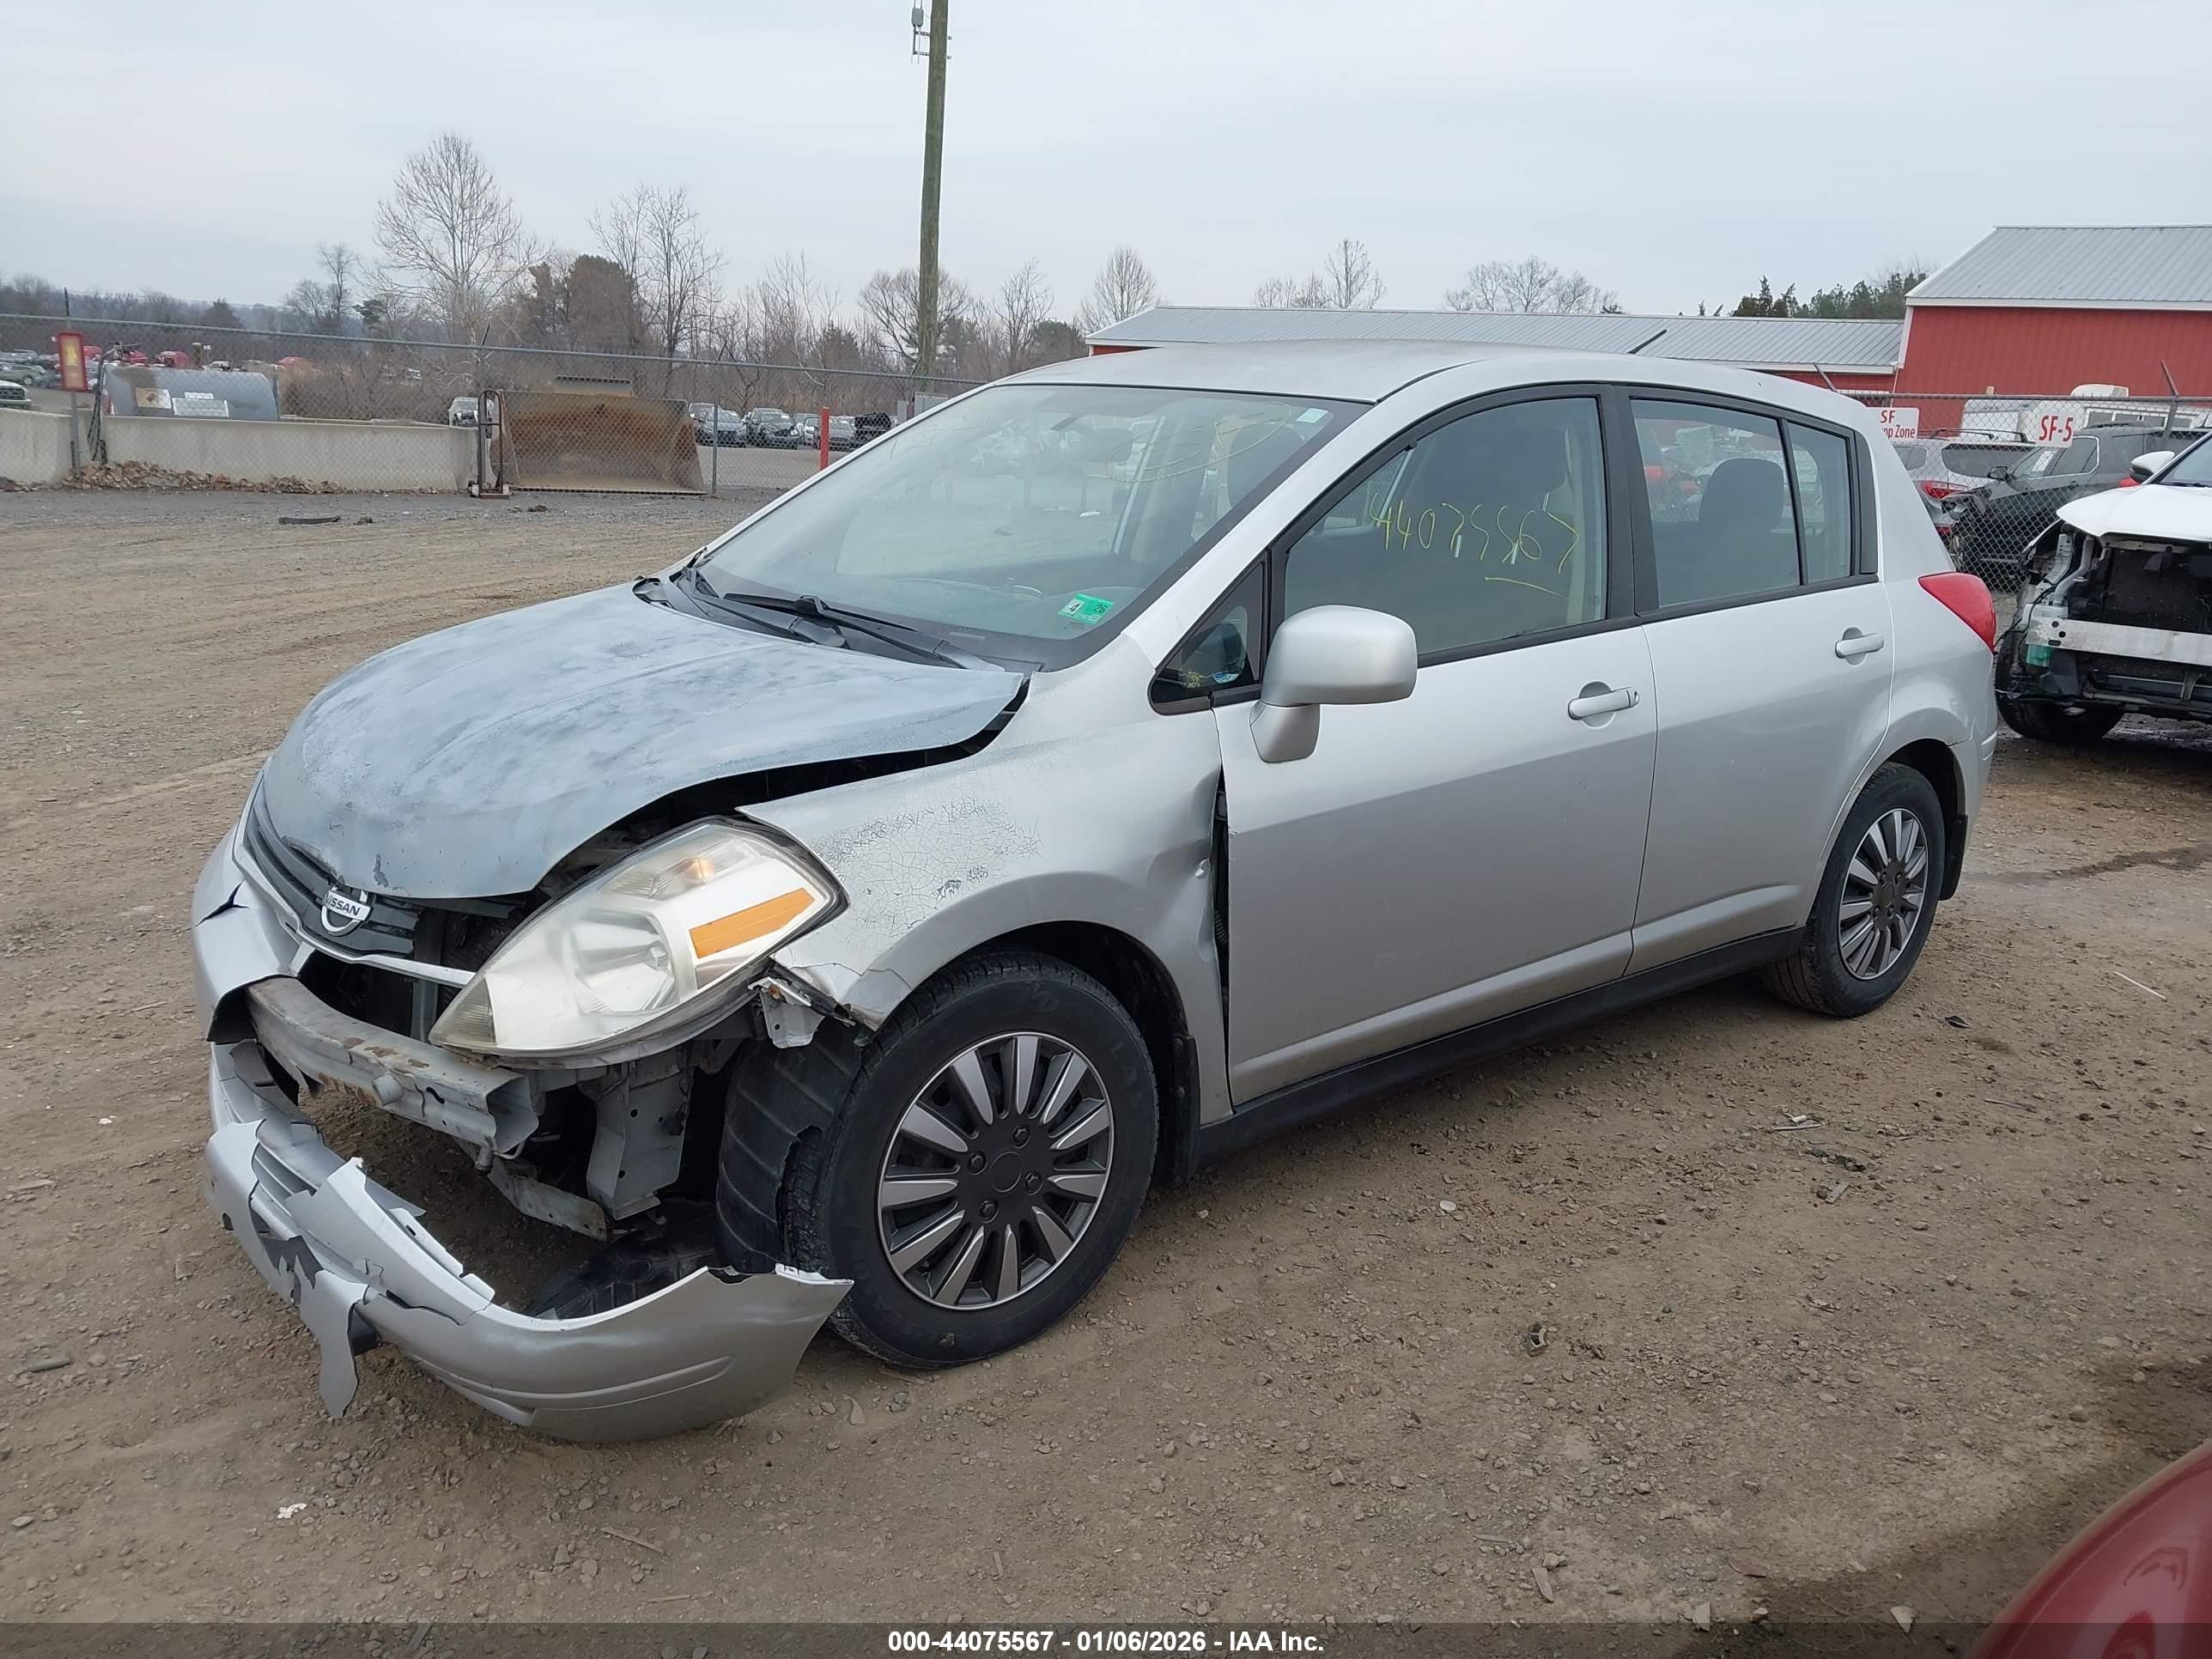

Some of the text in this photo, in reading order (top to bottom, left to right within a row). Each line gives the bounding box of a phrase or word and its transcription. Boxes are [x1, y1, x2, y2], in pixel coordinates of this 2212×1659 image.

[1881, 410, 1895, 423] SF
[1895, 424, 1916, 439] Zone
[2039, 415, 2074, 442] SF-5
[1369, 491, 1580, 574] 44075567
[324, 893, 361, 916] NISSAN
